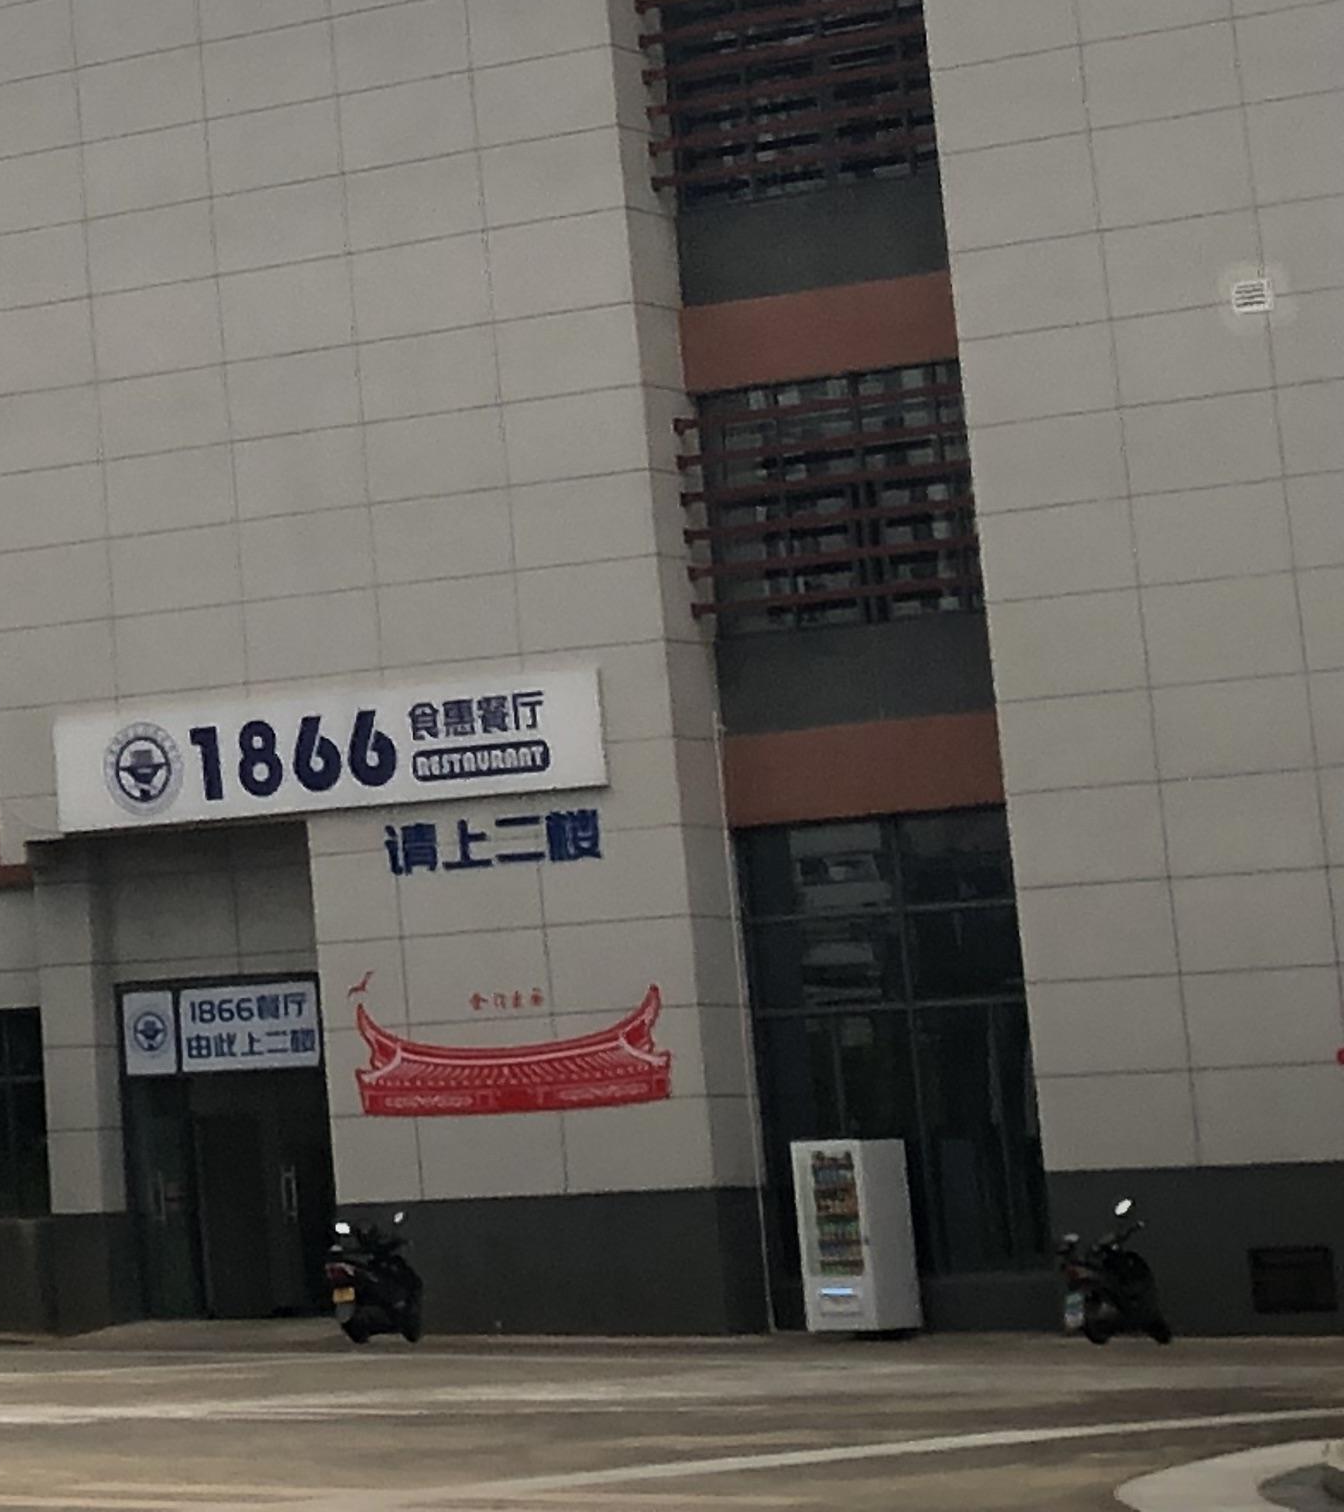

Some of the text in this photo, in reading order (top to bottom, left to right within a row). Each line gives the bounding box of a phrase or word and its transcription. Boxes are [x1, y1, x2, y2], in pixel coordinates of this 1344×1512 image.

[189, 709, 398, 802] 1866
[409, 690, 545, 740] 食惠餐厅
[415, 744, 545, 777] RESTAURANT
[384, 808, 602, 876] 请上二楼
[185, 1028, 316, 1059] 由此上二楼
